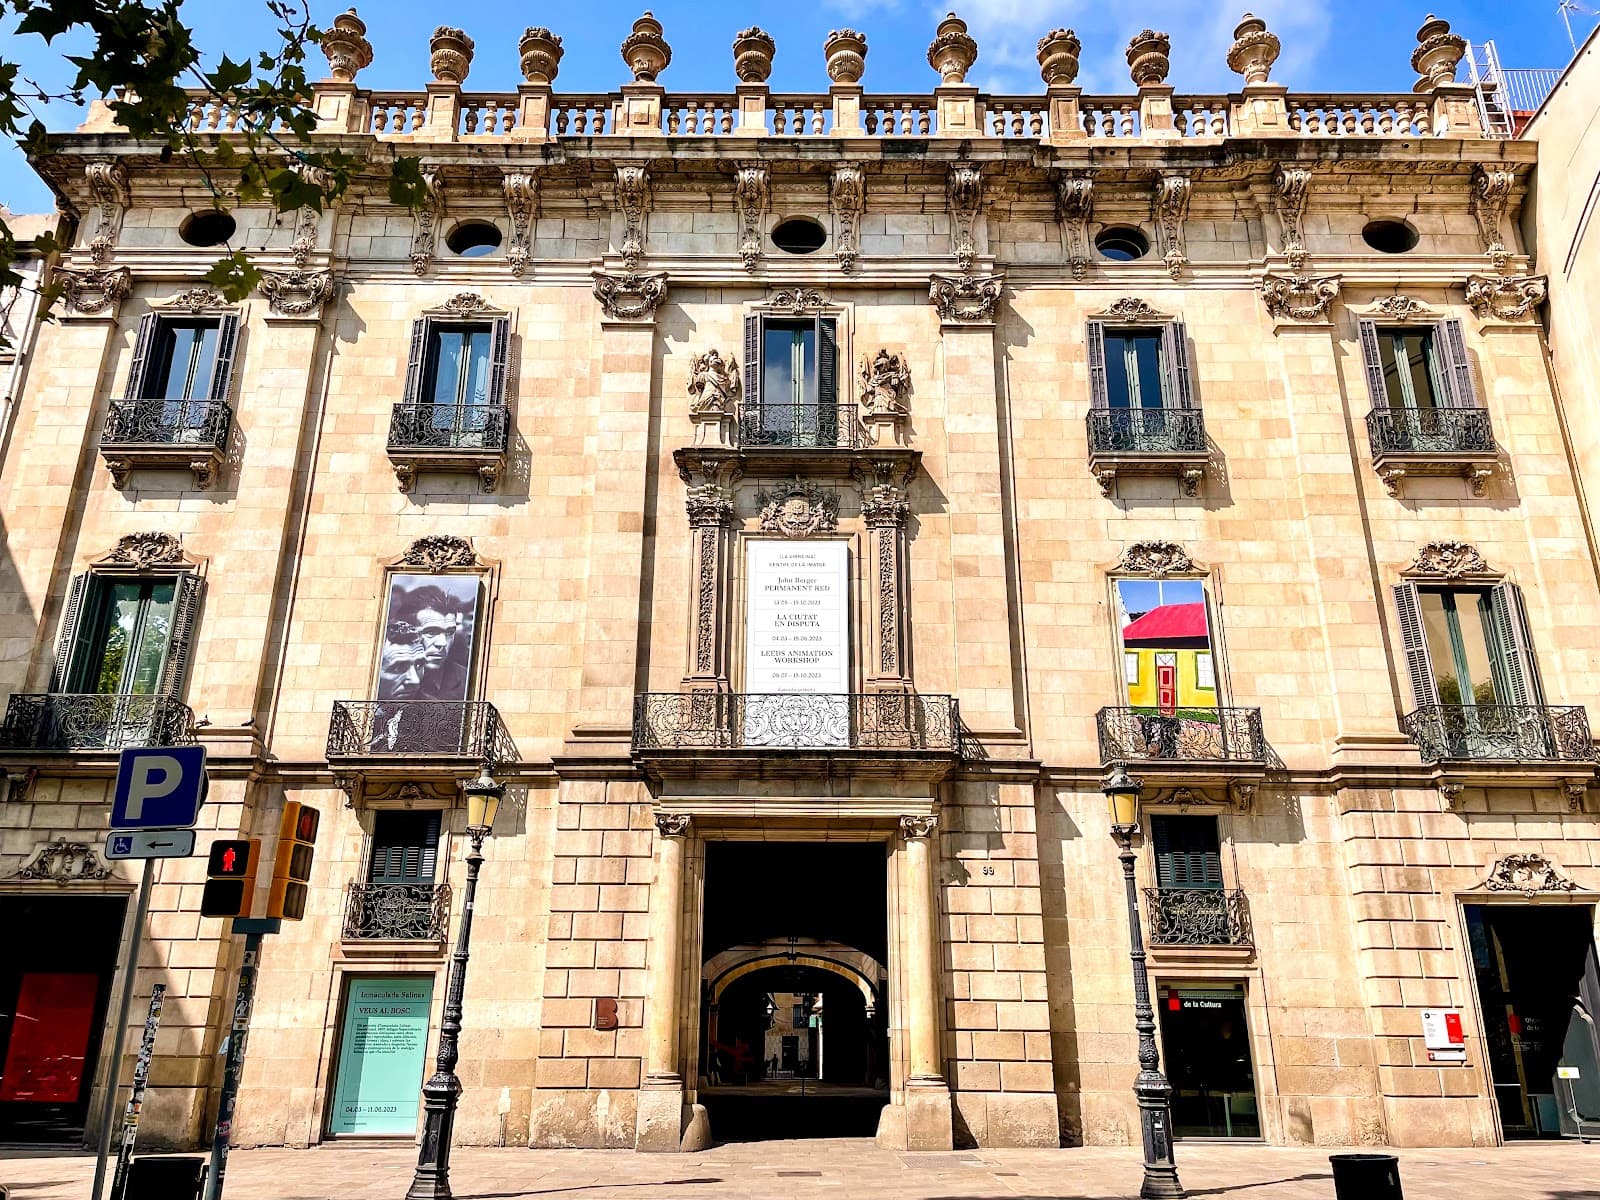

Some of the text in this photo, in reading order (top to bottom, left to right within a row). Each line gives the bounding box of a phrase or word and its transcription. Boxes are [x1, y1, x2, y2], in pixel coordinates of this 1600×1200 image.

[778, 576, 817, 585] John Berger
[124, 755, 183, 820] P
[1193, 1000, 1199, 1008] la
